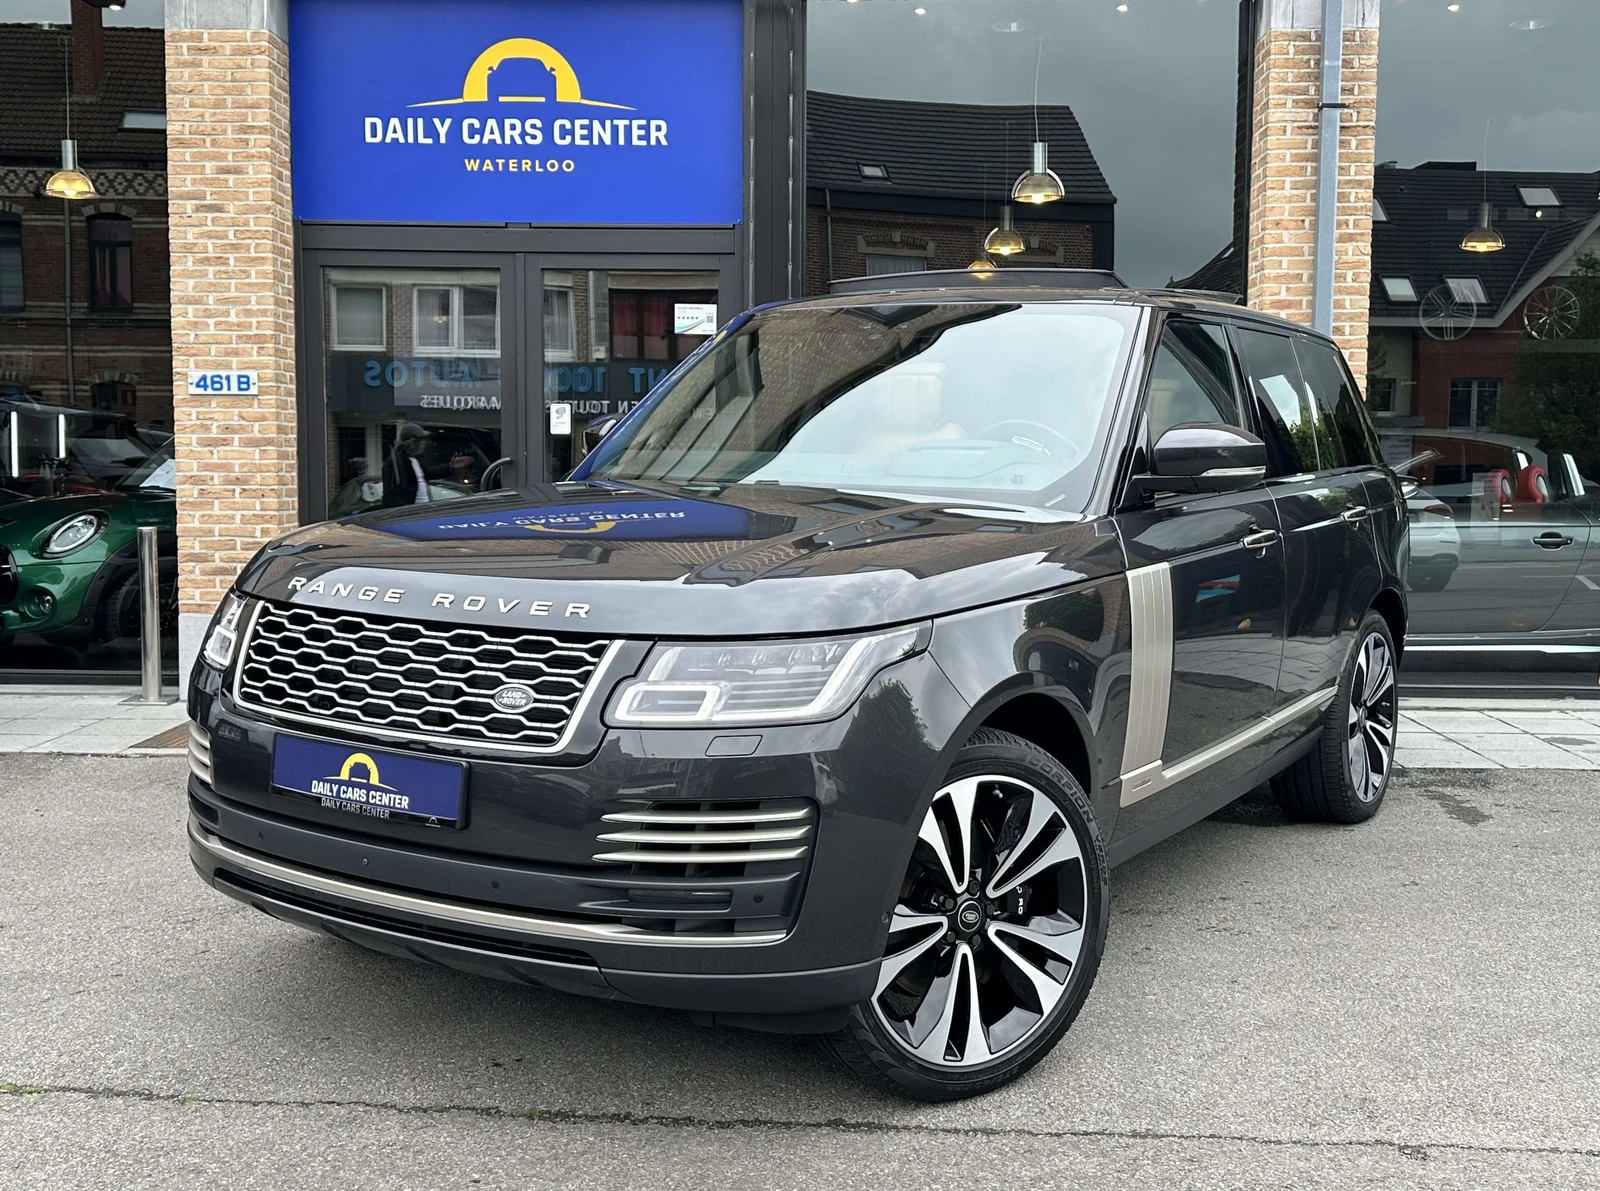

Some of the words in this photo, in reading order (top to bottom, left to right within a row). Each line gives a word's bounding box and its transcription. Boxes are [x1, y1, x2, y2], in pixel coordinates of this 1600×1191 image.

[364, 117, 452, 144] DAILY
[462, 118, 543, 145] CARS
[553, 119, 668, 146] CENTER
[464, 158, 575, 172] WATERLOO
[195, 374, 231, 391] 461
[237, 374, 251, 391] B
[287, 577, 405, 603] RANGE
[431, 592, 590, 619] ROVER
[311, 780, 339, 797] DAILY
[340, 786, 367, 802] CARS
[368, 791, 409, 809] CENTER
[321, 797, 341, 809] DAILY
[341, 801, 360, 814] CARS
[362, 805, 390, 819] CENTER
